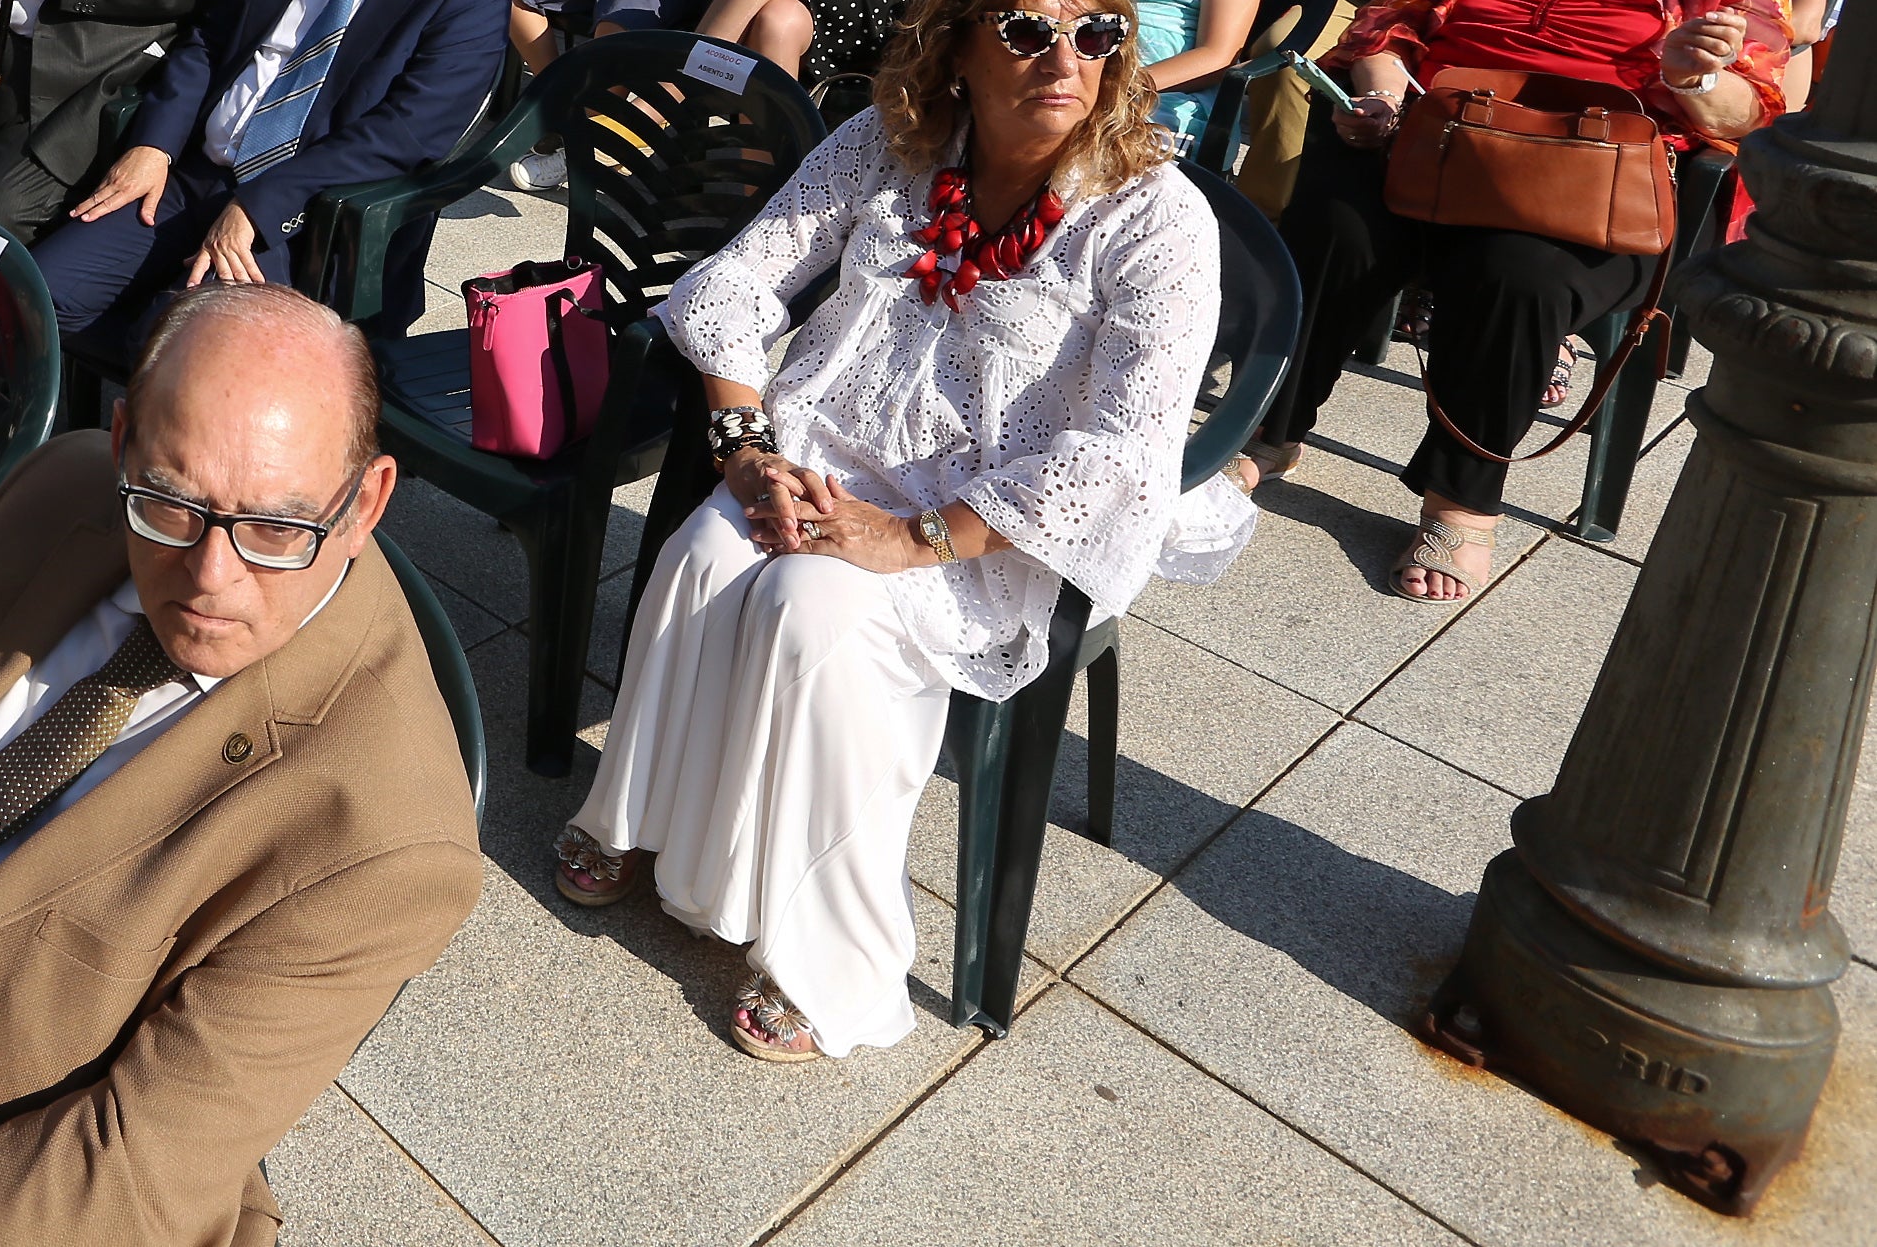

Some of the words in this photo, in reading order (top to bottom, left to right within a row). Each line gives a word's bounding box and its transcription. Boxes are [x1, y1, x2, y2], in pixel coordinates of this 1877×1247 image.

[705, 48, 735, 63] ACOTADO
[735, 58, 743, 66] C
[698, 64, 724, 78] ASIENTO
[724, 72, 735, 82] 39
